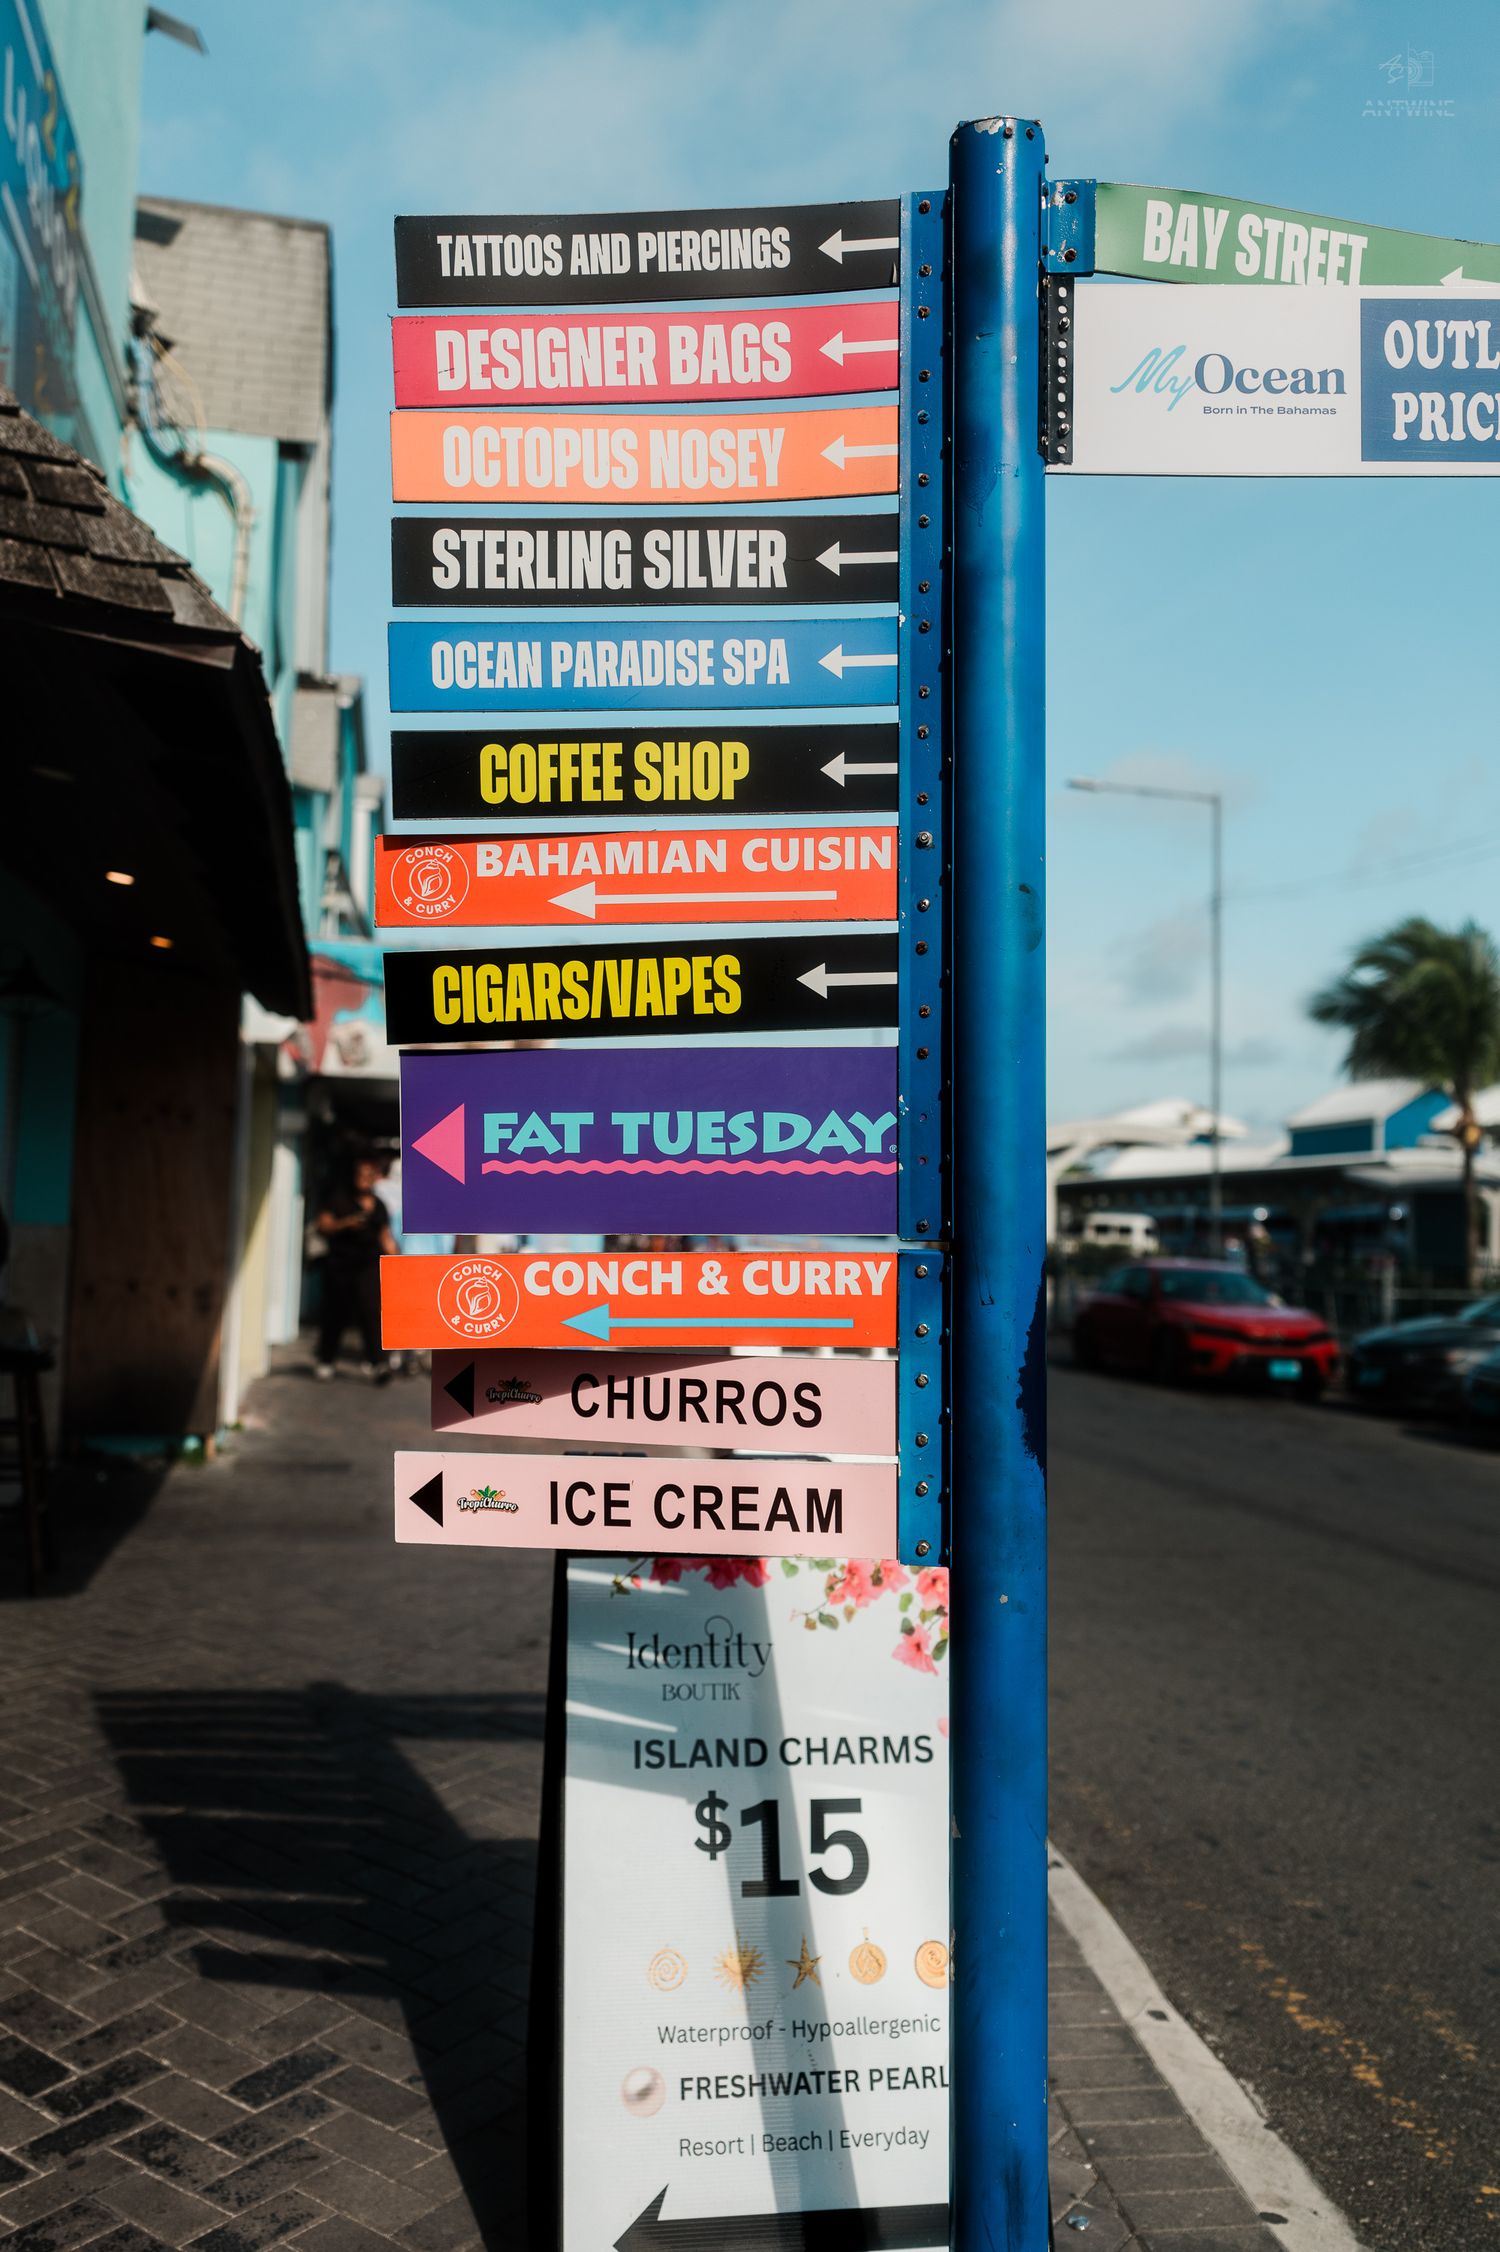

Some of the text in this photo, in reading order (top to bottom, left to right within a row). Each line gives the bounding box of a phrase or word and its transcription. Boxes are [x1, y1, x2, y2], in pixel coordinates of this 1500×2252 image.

[437, 226, 791, 277] TATTOOS AND PIERCINGS
[1143, 199, 1368, 285] BAY STREET
[435, 321, 792, 391] DESIGNER BAGS
[1203, 406, 1337, 415] Born in The Bahamas
[1391, 391, 1500, 442] PRIC
[442, 425, 785, 489] OCTOPUS NOSEY
[432, 528, 788, 590] STERLING SILVER
[431, 638, 790, 690] OCEAN PARADISE SPA
[480, 741, 750, 805] COFFEE SHOP
[405, 846, 454, 864] CONCH
[476, 835, 892, 878] BAHAMIAN CUISIN
[403, 894, 457, 915] & CURRY
[432, 954, 741, 1025] CIGARS/VAPES
[483, 1111, 595, 1155] FAT
[452, 1263, 503, 1282] CONCH
[524, 1261, 892, 1296] CONCH & CURRY
[451, 1313, 506, 1334] & CURRY
[486, 1387, 543, 1404] TropiChurro
[570, 1373, 823, 1428] CHURROS
[457, 1497, 519, 1513] TropiChurro
[550, 1480, 844, 1534] ICE CREAM
[626, 1616, 773, 1678] Identity
[661, 1683, 741, 1702] BOUTIK
[633, 1735, 934, 1770] ISLAND CHARMS
[694, 1790, 870, 1898] $15
[657, 2020, 774, 2046] Waterproof
[792, 2014, 941, 2043] Hypoallergenic
[680, 2065, 949, 2101] FRESHWATER PEARL
[679, 2136, 744, 2157] Resort
[763, 2131, 823, 2153] Beach
[840, 2126, 930, 2150] Everyday
